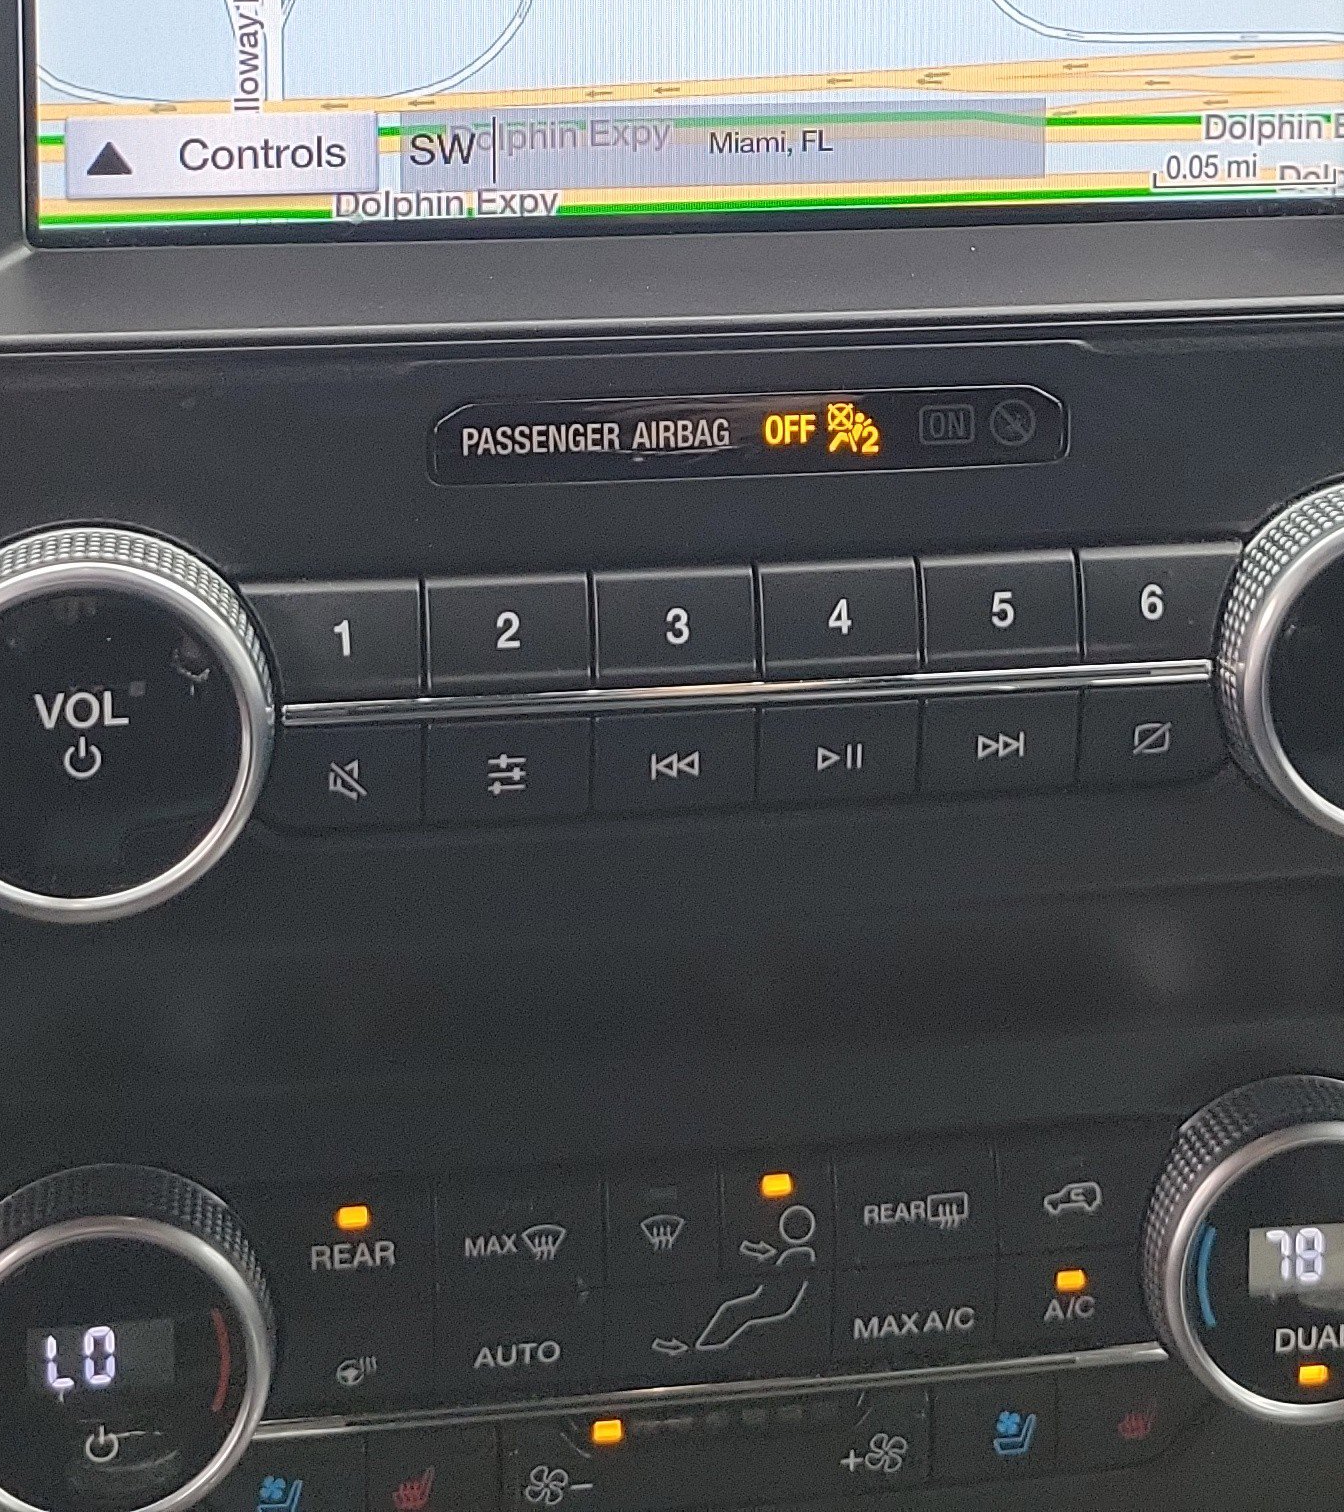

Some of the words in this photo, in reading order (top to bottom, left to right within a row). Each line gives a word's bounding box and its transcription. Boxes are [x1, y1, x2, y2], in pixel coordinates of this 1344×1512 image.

[590, 119, 673, 152] Expy
[709, 131, 792, 157] Miami,
[802, 129, 834, 152] FL
[1205, 113, 1323, 146] Dolphin
[178, 137, 347, 173] Controls
[410, 133, 476, 166] SW
[1166, 154, 1219, 180] 0.05
[1227, 153, 1257, 177] mi
[336, 192, 464, 219] Dolphin
[462, 422, 620, 456] PASSENGER
[632, 418, 731, 450] AIRBAG
[764, 414, 816, 445] OFF
[929, 411, 965, 439] ON
[827, 598, 853, 634] 4
[991, 591, 1015, 628] 5
[1140, 584, 1164, 620] 6
[333, 620, 352, 656] 1
[496, 612, 522, 649] 2
[665, 607, 690, 645] 3
[35, 691, 130, 731] VOL
[864, 1200, 925, 1226] REAR
[311, 1241, 396, 1271] REAR
[464, 1234, 517, 1258] MAX
[853, 1314, 917, 1340] MAX
[924, 1306, 976, 1332] A/C
[1044, 1296, 1096, 1323] A/C
[472, 1340, 562, 1370] AUTO
